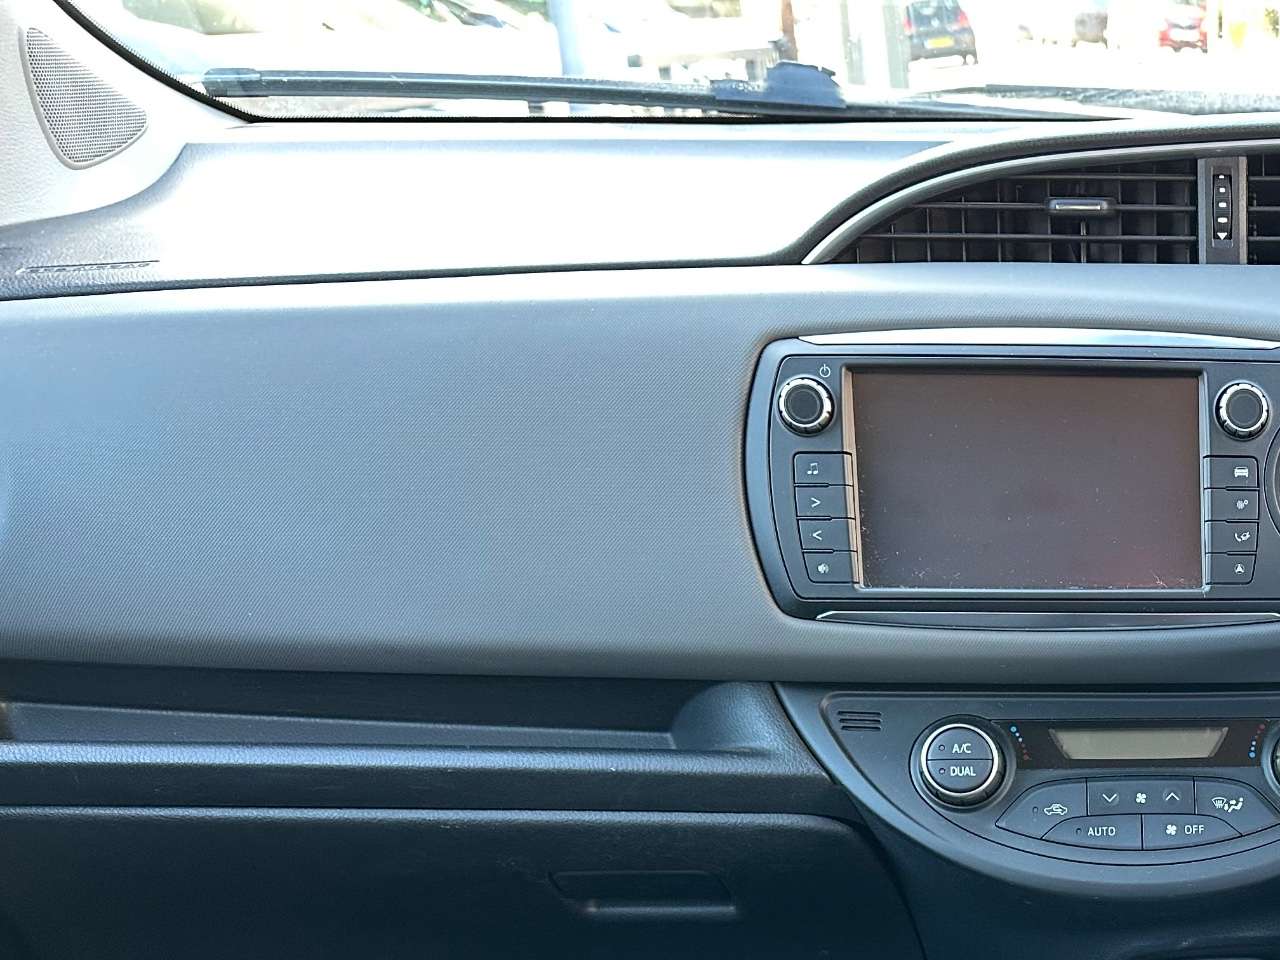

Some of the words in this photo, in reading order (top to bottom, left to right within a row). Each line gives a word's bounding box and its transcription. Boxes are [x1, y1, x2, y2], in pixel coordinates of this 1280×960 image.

[952, 743, 971, 754] A/C
[950, 766, 976, 777] DUAL
[1087, 826, 1116, 837] AUTO
[1184, 824, 1204, 836] OFF
